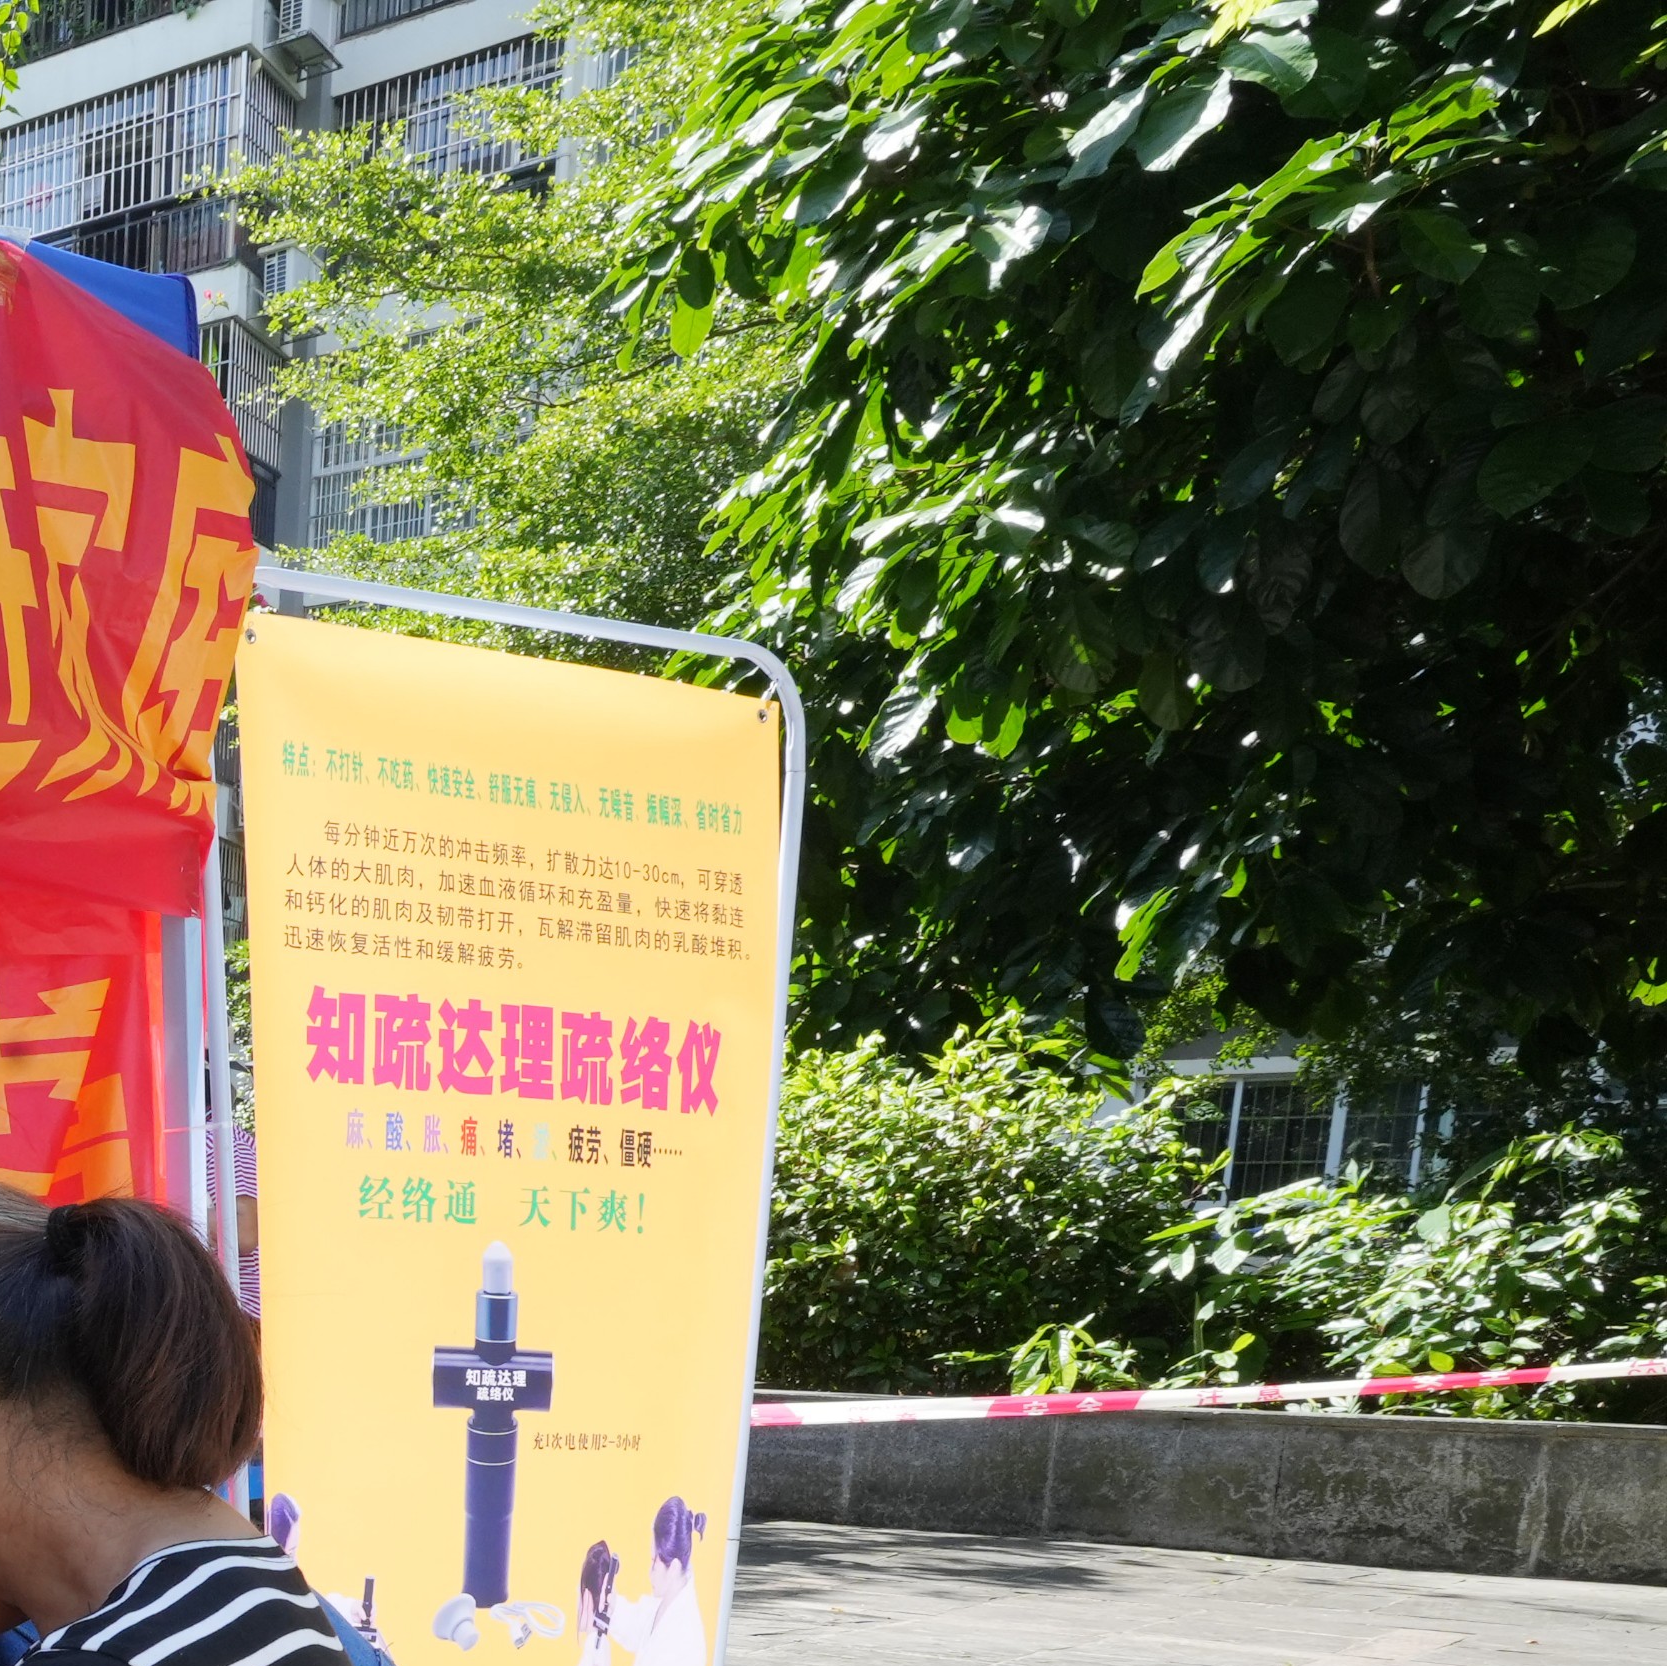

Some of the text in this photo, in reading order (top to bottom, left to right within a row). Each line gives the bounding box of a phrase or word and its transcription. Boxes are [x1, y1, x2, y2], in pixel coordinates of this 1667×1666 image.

[283, 923, 526, 971] 迅速恢复活性和缓解疲劳。
[305, 985, 722, 1117] 知疏达理疏络仪
[357, 1175, 478, 1226] 经络通
[465, 1368, 527, 1387] 知疏达理
[476, 1387, 515, 1402] 疏络仪
